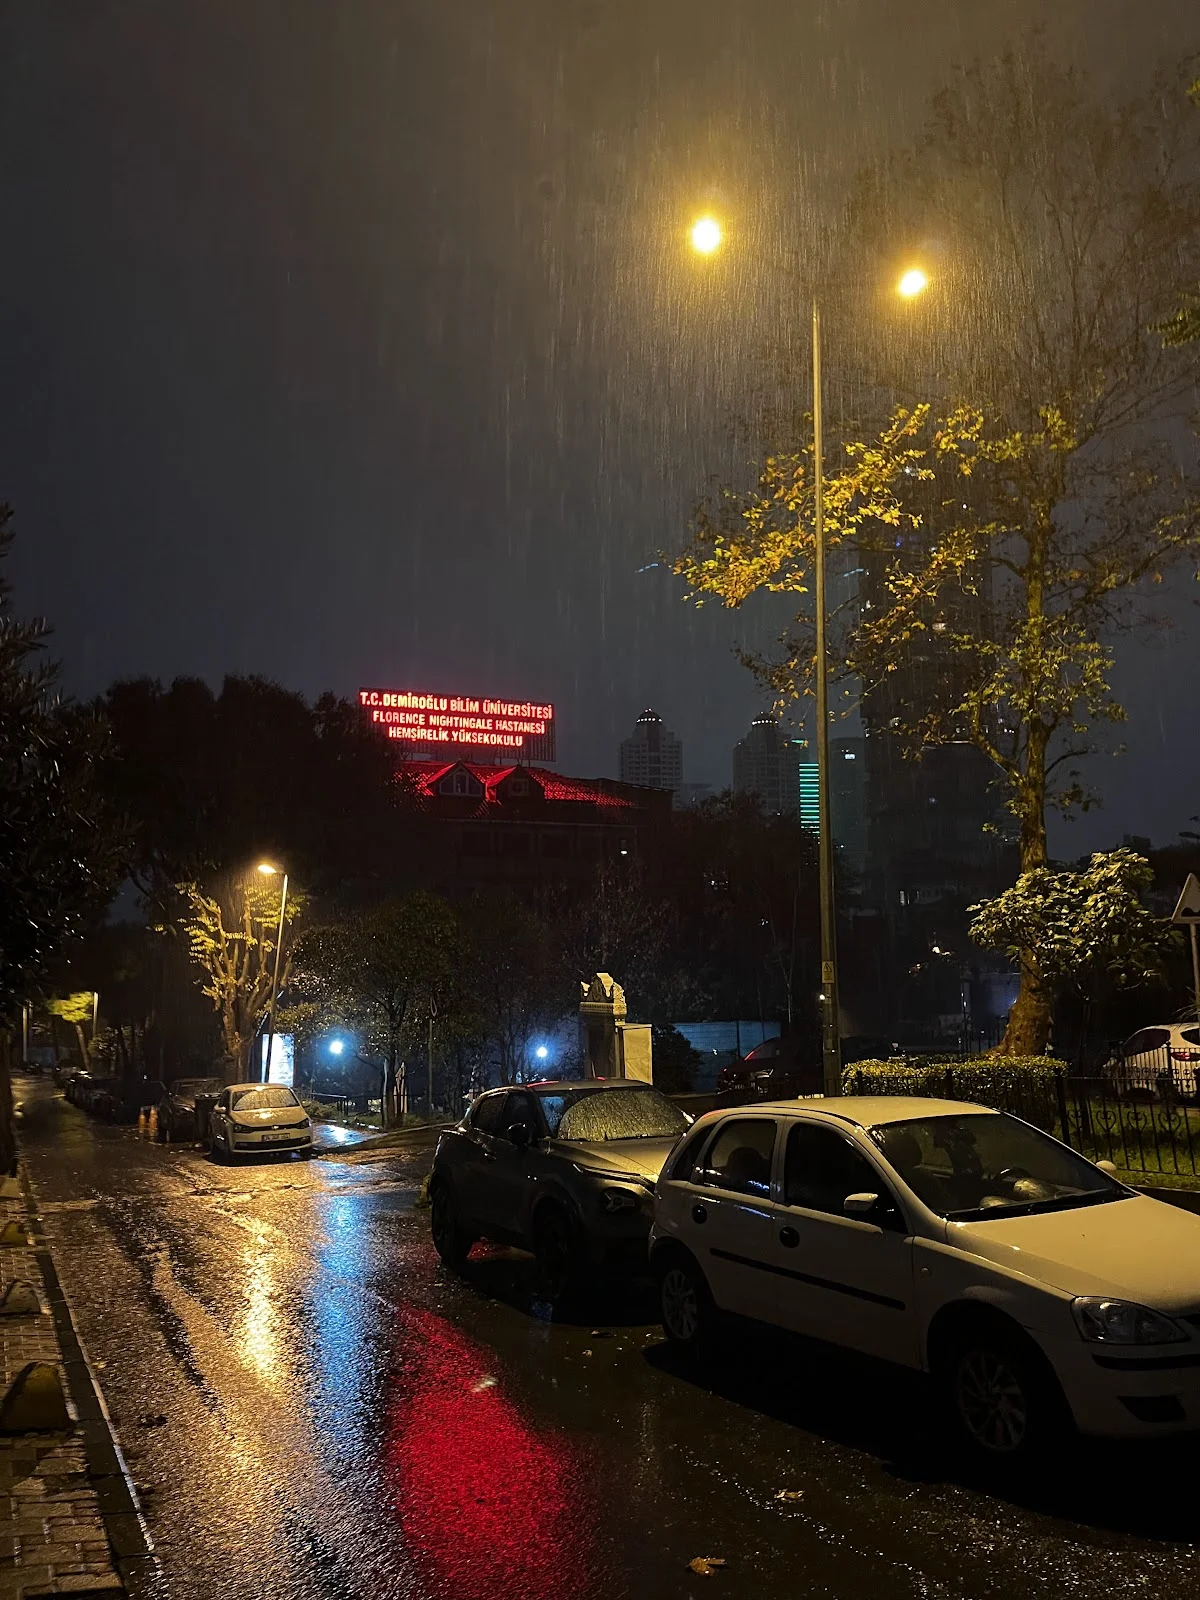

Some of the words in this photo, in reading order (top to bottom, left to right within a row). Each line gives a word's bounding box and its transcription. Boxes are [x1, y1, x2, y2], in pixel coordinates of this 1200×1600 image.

[450, 697, 479, 713] BİLİM
[483, 699, 552, 719] ÜNİVERSİTESİ
[373, 710, 425, 725] FLORENCE
[429, 714, 493, 730] NIGHTINGALE
[495, 719, 545, 734] HASTANESİ
[388, 726, 449, 741] HEMŞİRELİK
[451, 729, 523, 746] YÜKSEKOKULU
